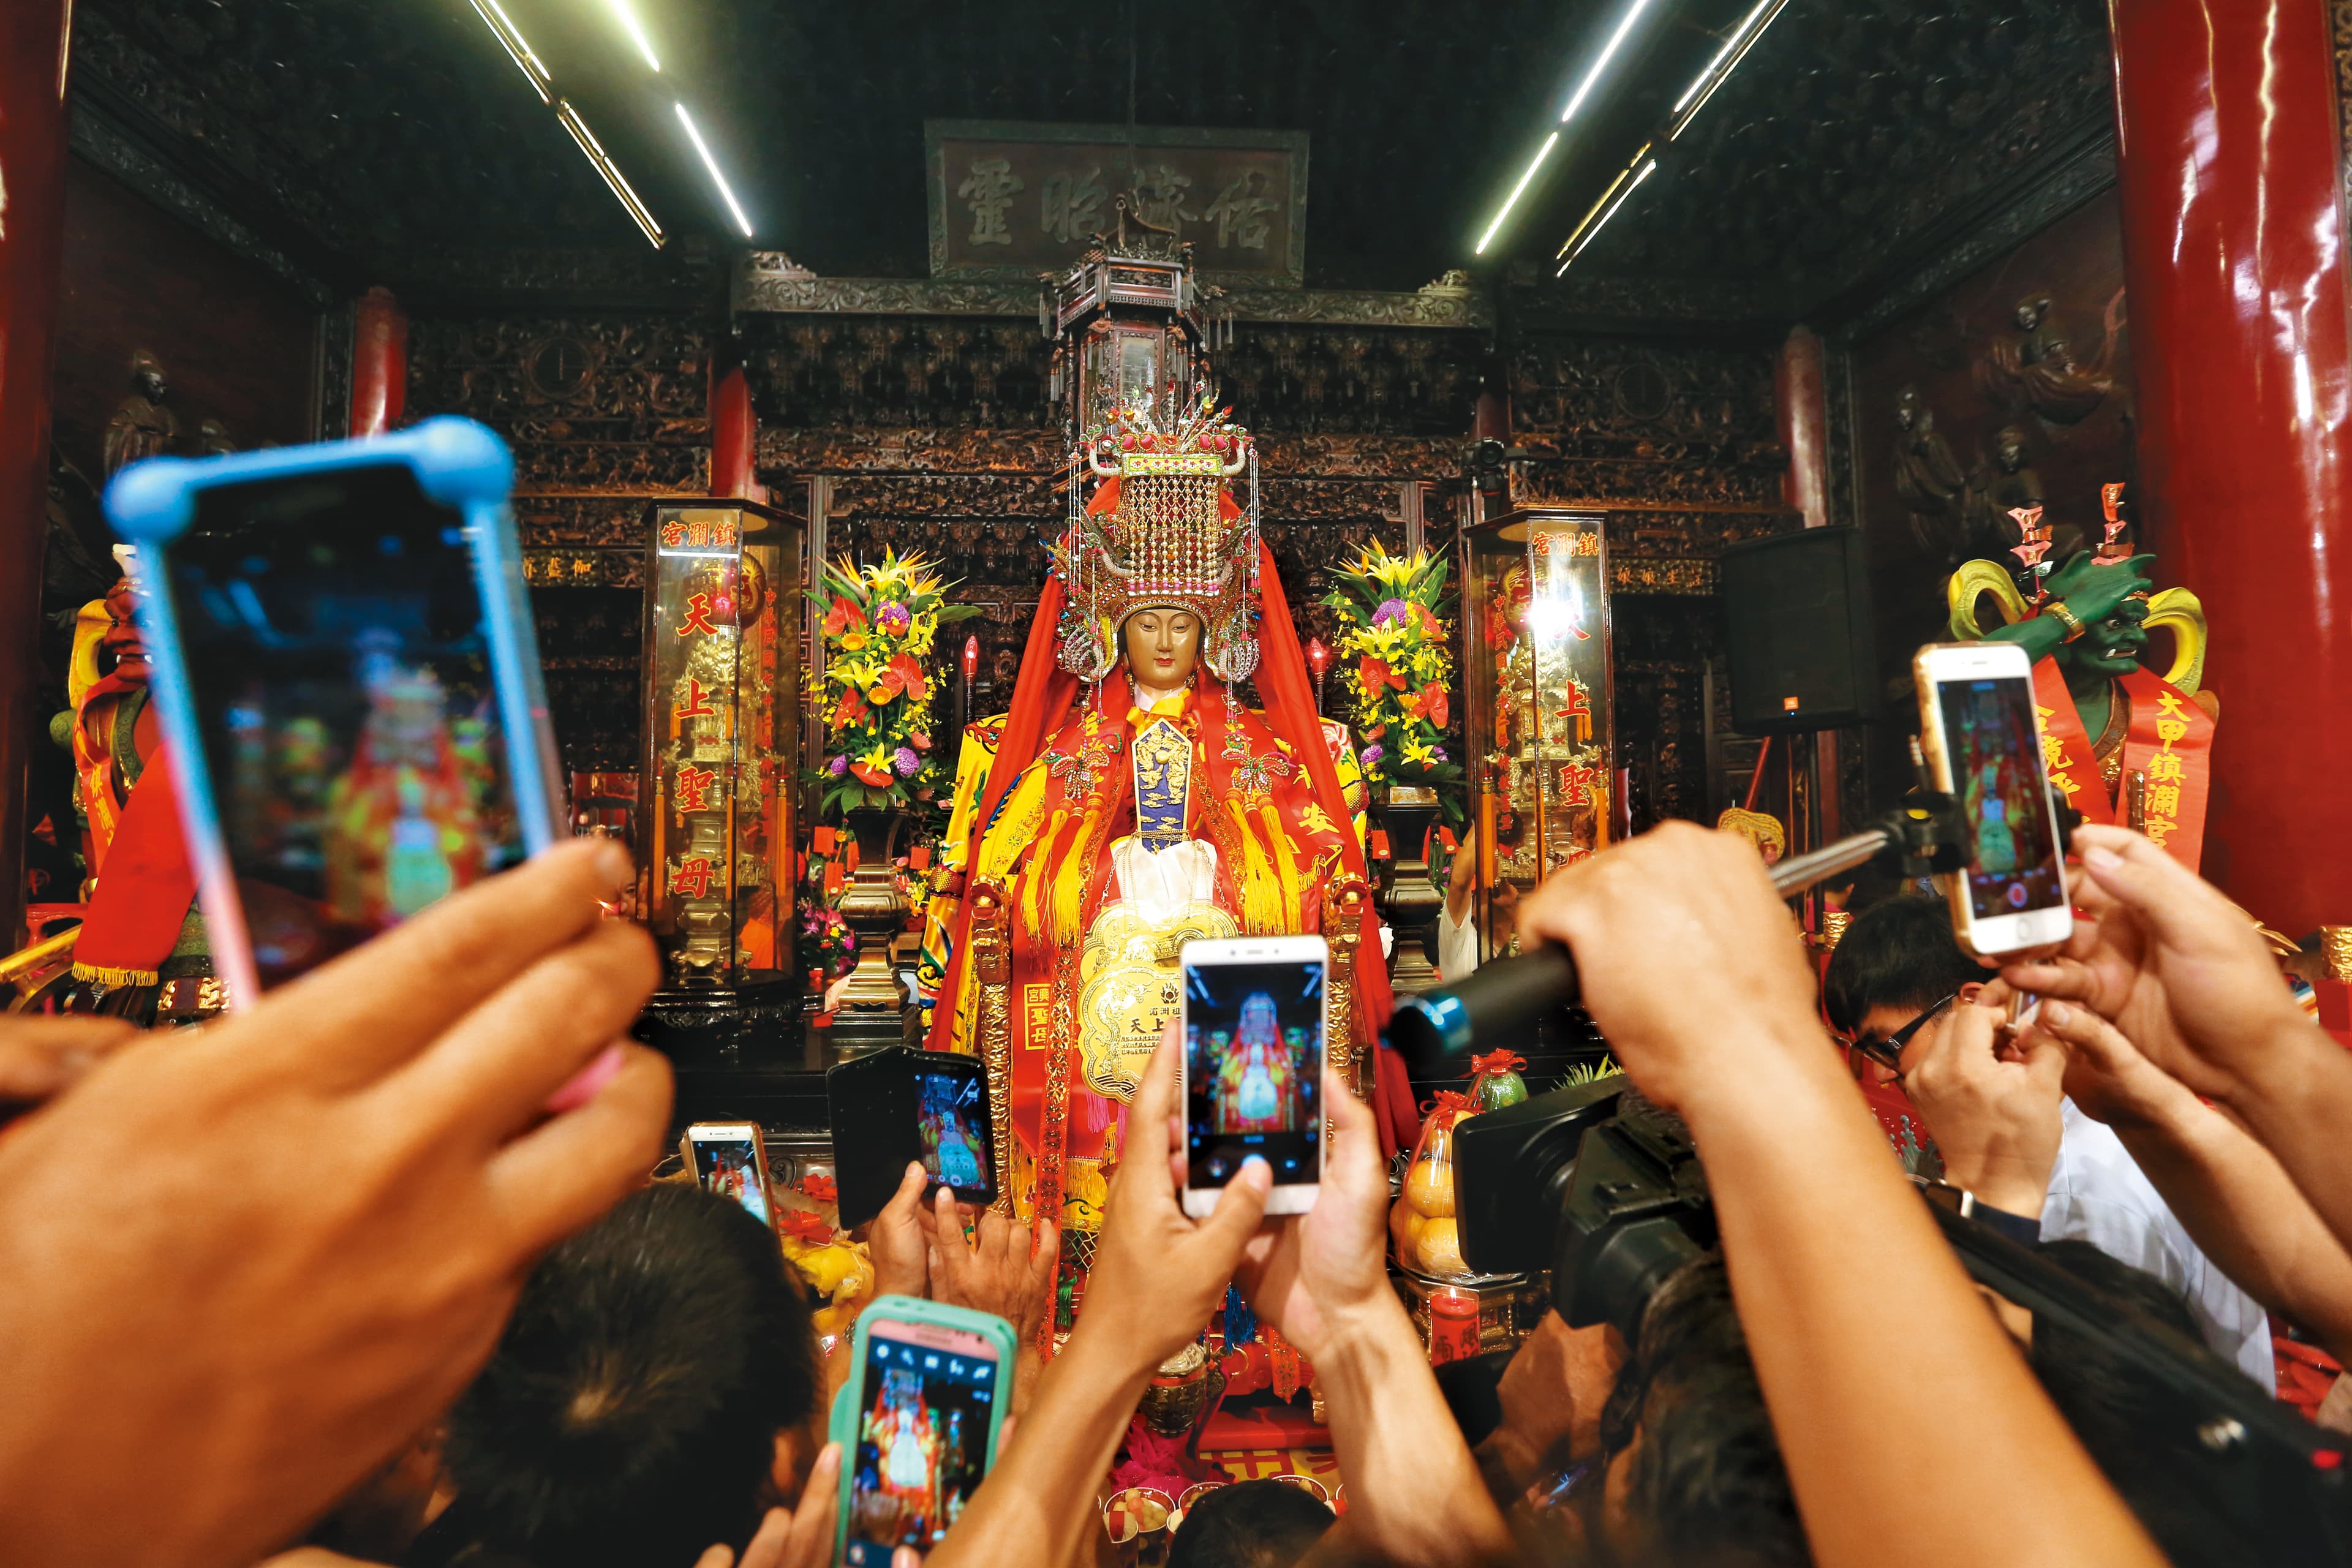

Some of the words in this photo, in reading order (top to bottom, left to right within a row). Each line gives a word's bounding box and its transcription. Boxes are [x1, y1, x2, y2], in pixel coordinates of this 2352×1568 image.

[662, 521, 736, 548] 鎮瀾宮
[1532, 531, 1599, 557] 鎮瀾宮
[671, 592, 718, 899] 天上聖母
[2144, 690, 2192, 849] 大甲鎮瀾宮
[1129, 1017, 1181, 1033] 天上
